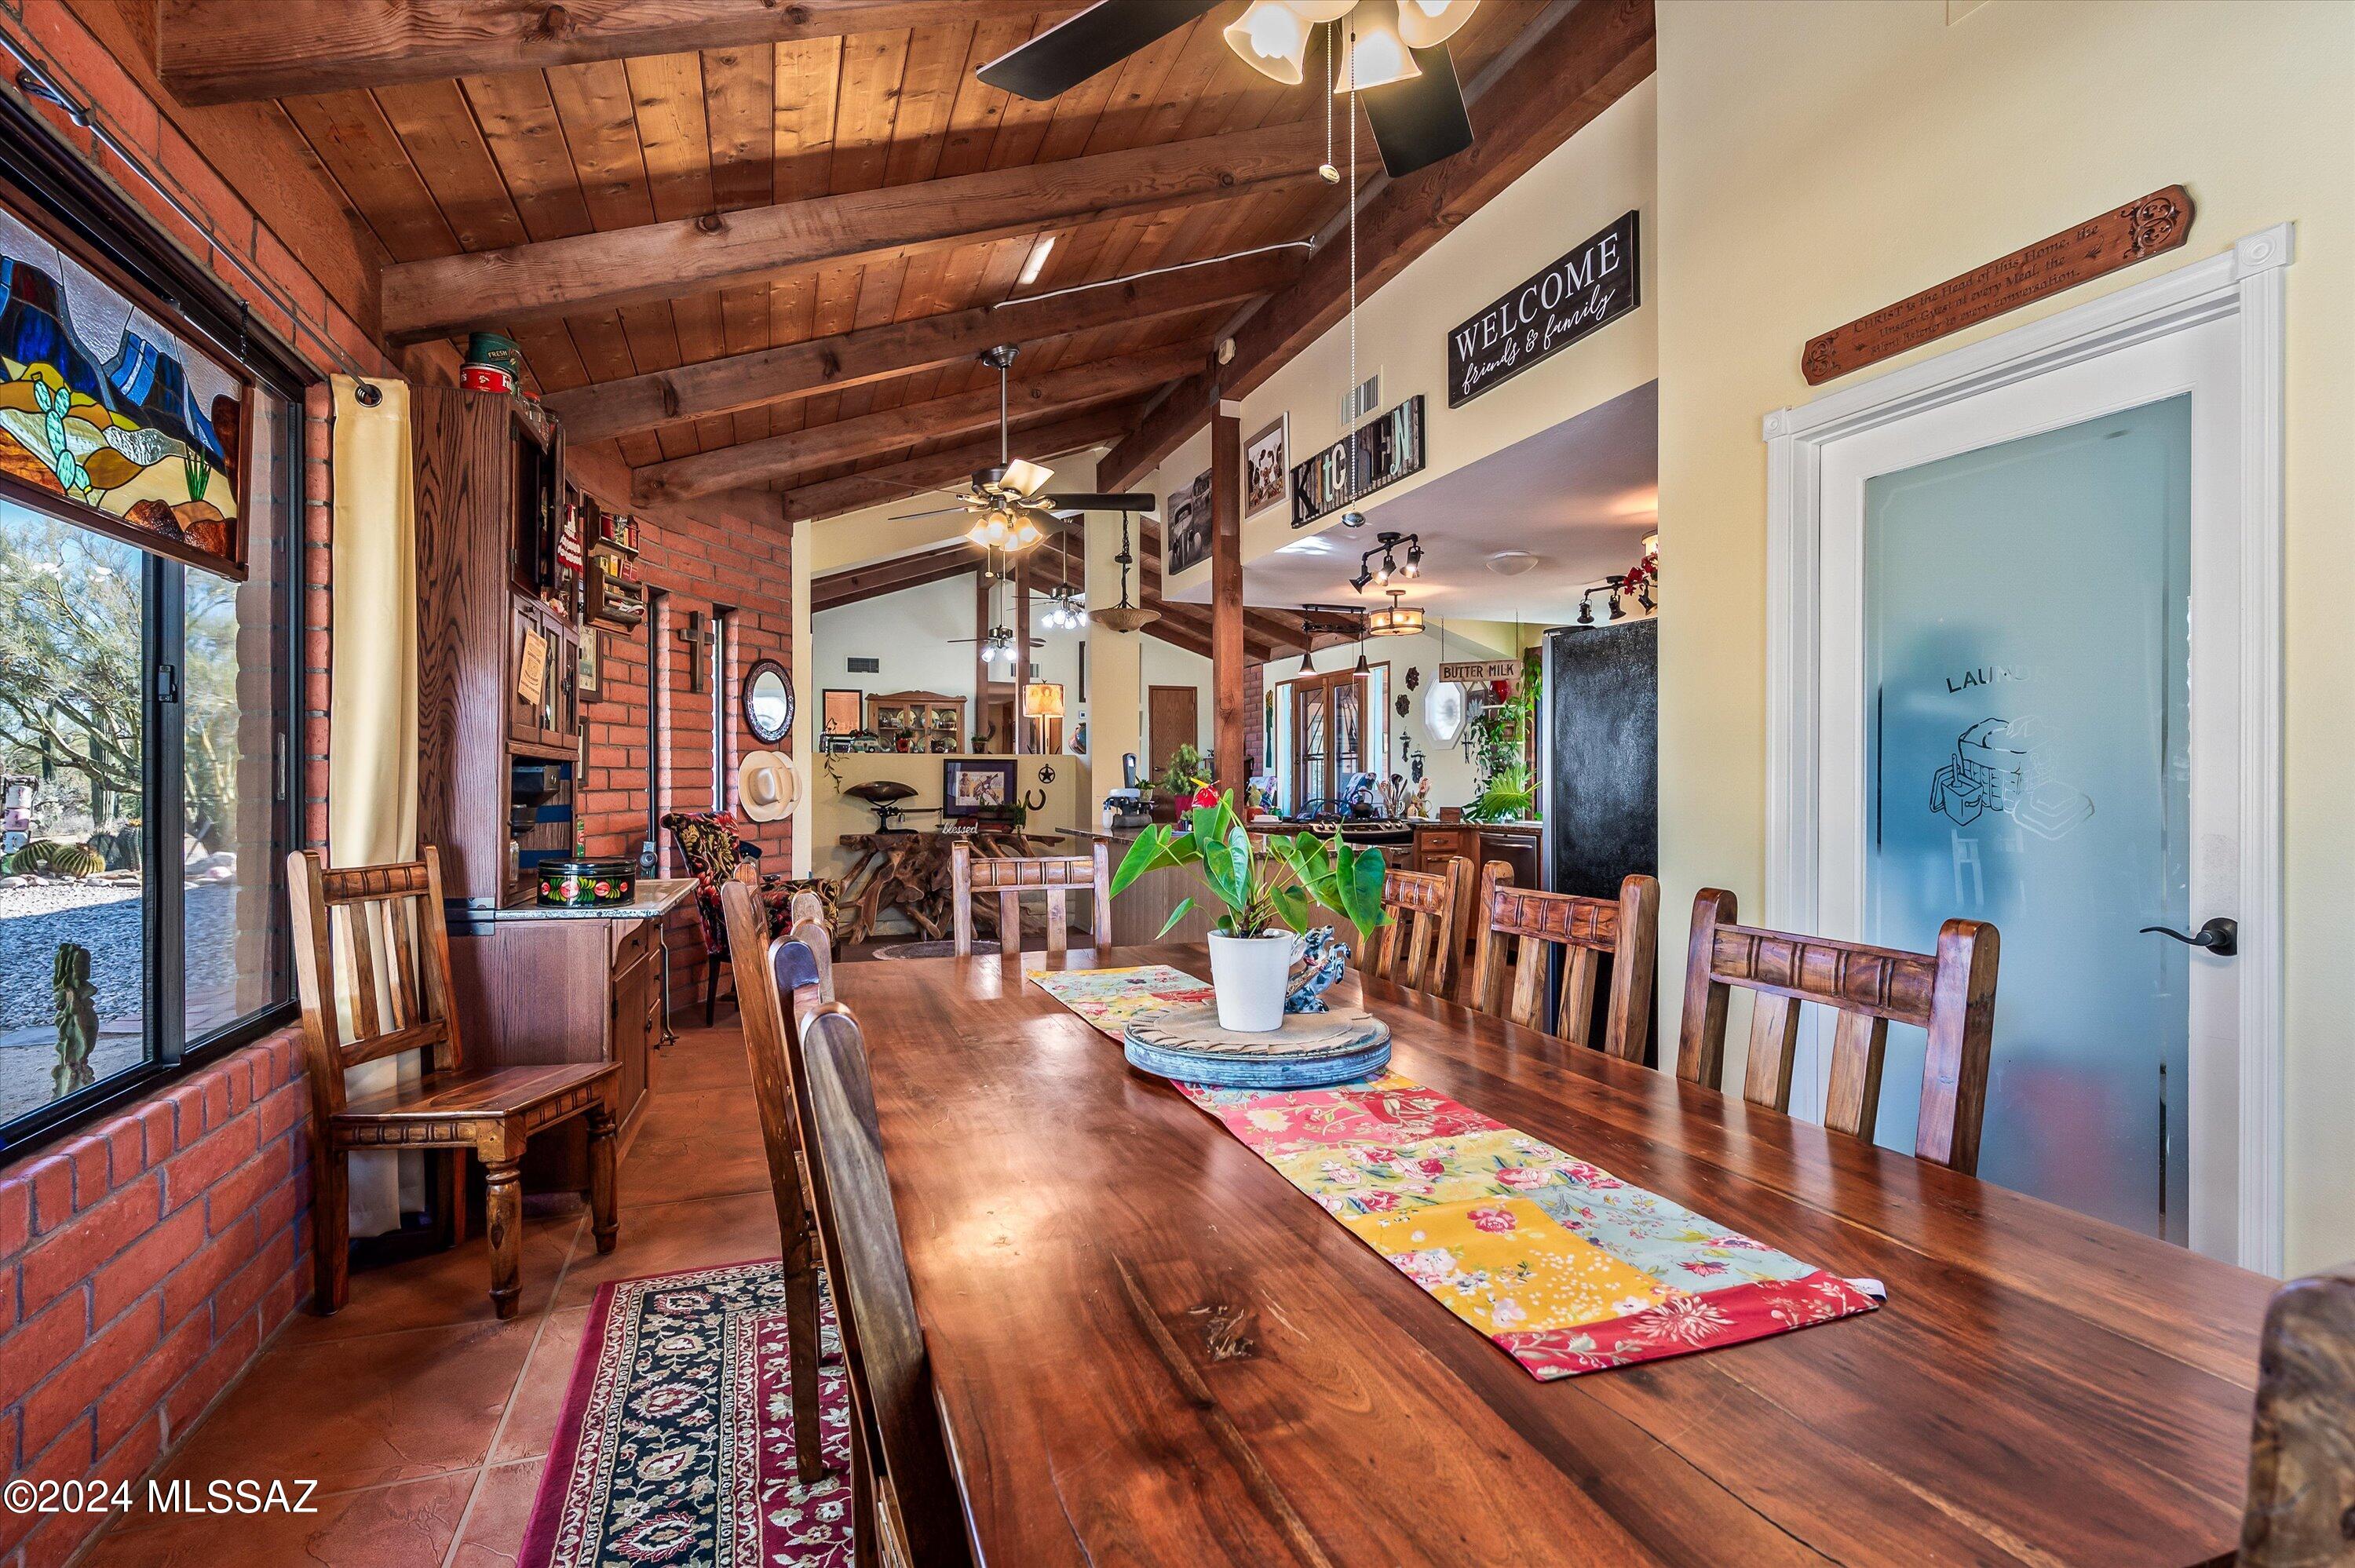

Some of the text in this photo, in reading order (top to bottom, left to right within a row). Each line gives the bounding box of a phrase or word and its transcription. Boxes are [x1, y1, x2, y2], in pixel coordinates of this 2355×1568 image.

[1455, 232, 1619, 362] WELCOME
[1906, 301, 1915, 311] is
[1919, 293, 1937, 306] the
[1941, 275, 1973, 297] Head
[1977, 267, 1991, 283] of
[1994, 258, 2019, 275] this
[2076, 224, 2099, 241] the
[1955, 294, 1966, 307] at
[1970, 283, 2002, 301] every
[2044, 255, 2066, 271] the
[1462, 284, 1616, 395] friends & family
[1444, 664, 1514, 679] BUTTER MILK
[942, 822, 978, 834] blessed
